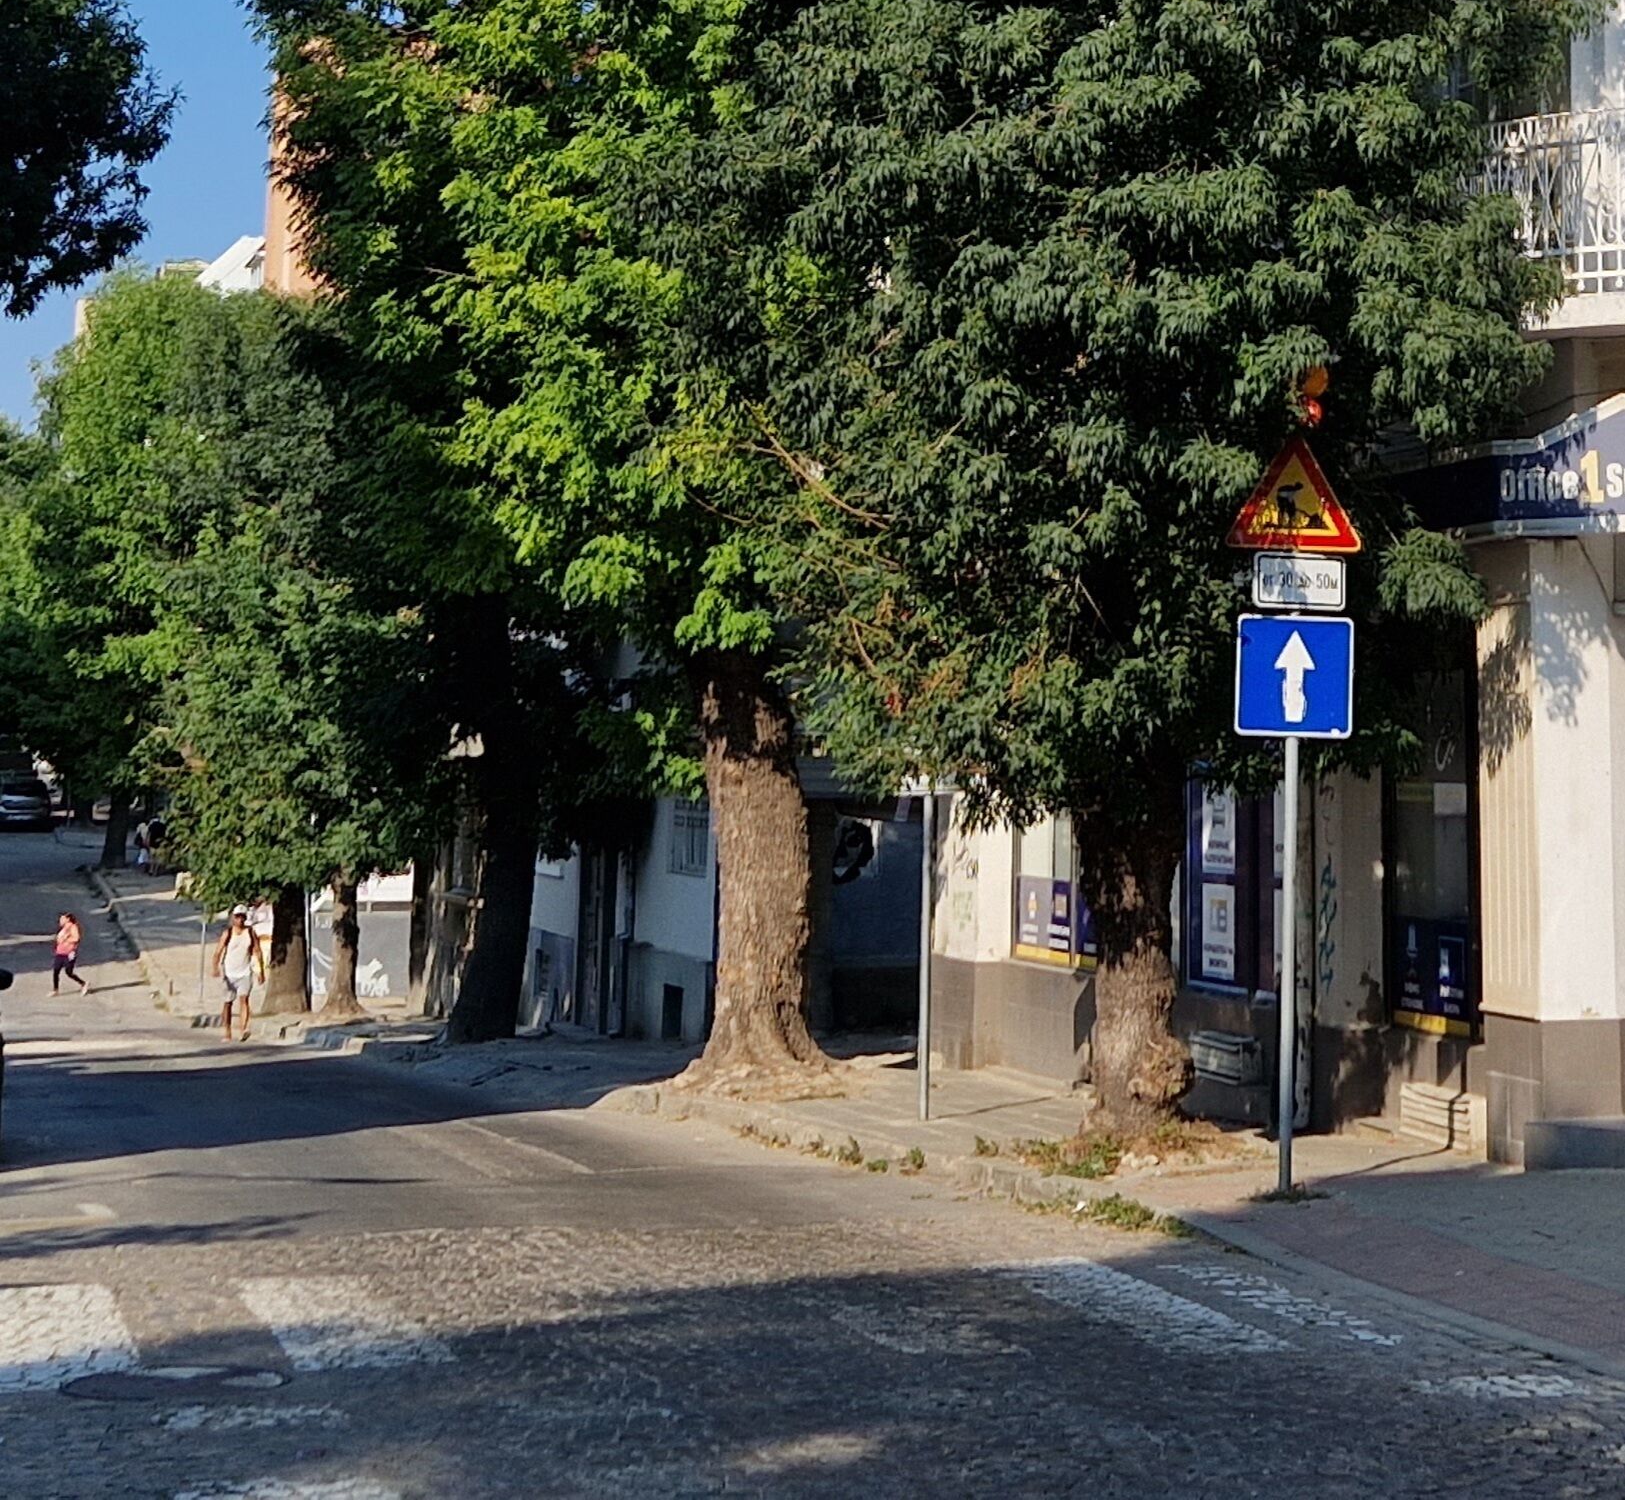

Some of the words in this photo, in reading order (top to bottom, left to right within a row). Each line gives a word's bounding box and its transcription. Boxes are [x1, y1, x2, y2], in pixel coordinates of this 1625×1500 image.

[1501, 464, 1580, 502] Office
[1580, 450, 1605, 503] 1
[1280, 572, 1293, 588] 30
